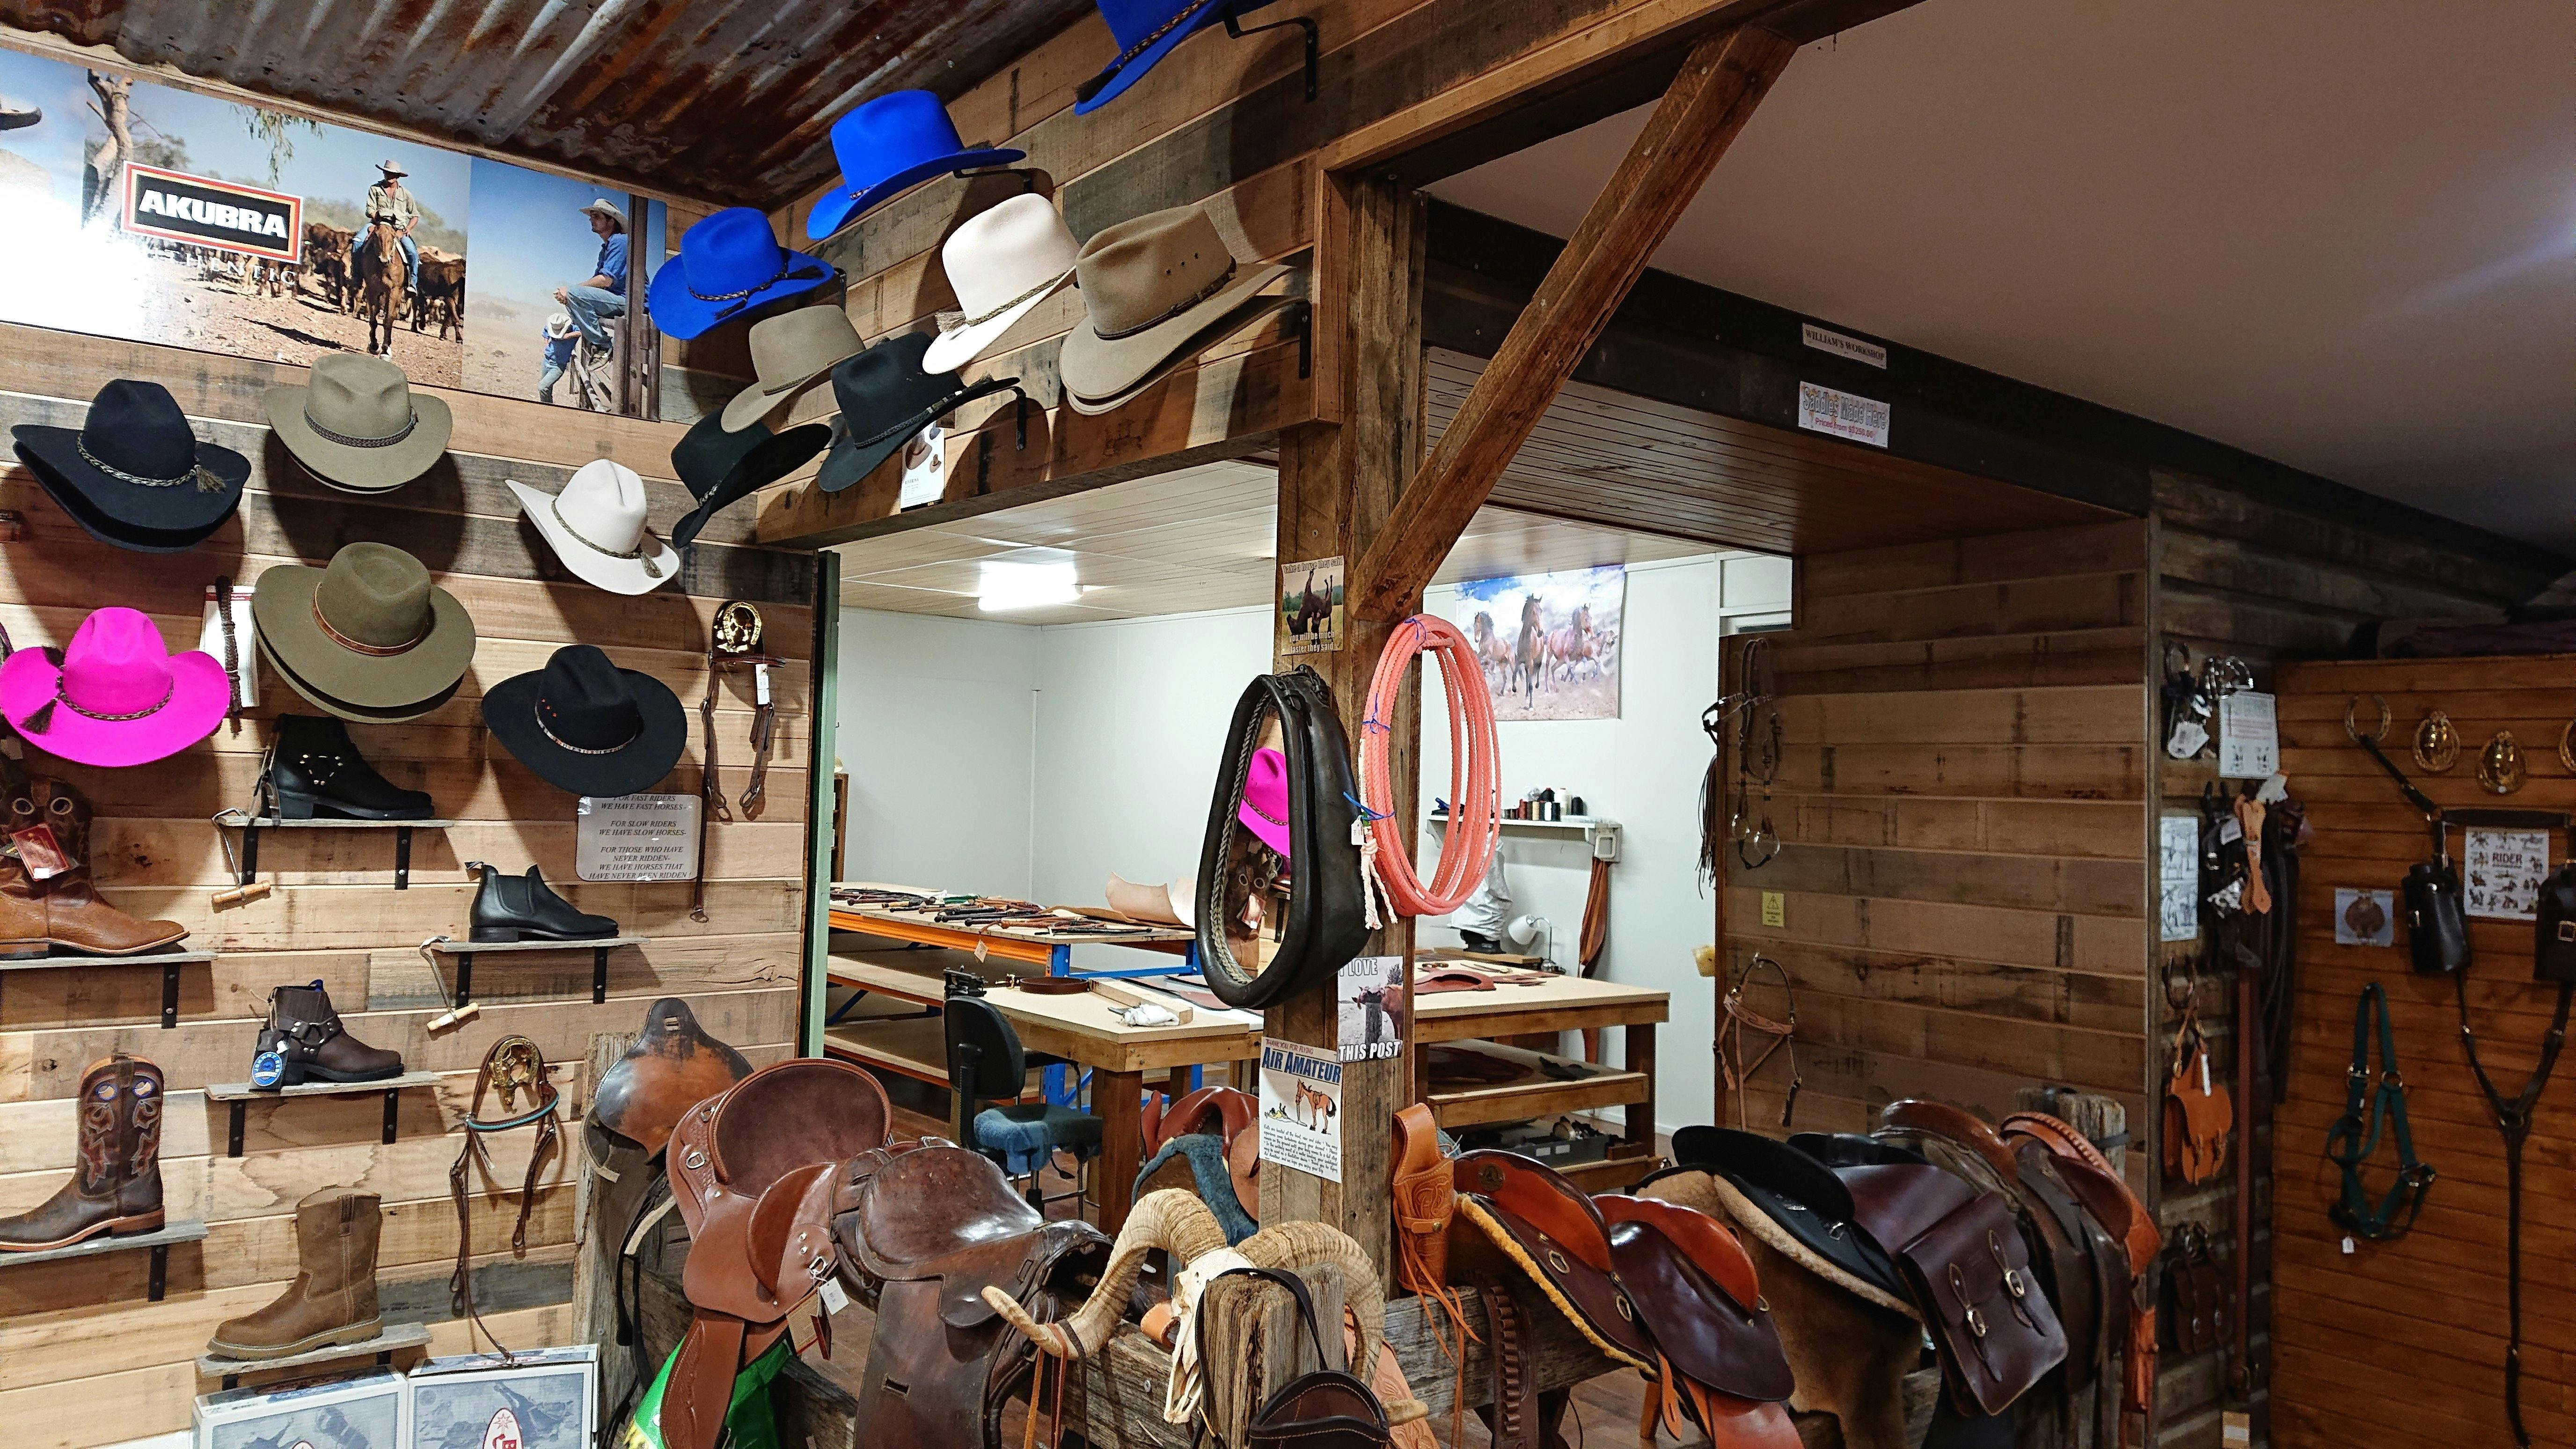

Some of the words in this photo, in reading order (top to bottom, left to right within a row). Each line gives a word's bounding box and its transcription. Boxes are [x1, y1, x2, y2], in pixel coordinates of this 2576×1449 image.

[139, 189, 288, 239] AKUBRA
[146, 247, 296, 285] THENTIC
[1806, 329, 1844, 349] WILLIAM'S
[1846, 342, 1884, 360] WORKSHOP
[1803, 387, 1839, 417] Saddles
[1301, 562, 1317, 571] horse
[1318, 560, 1330, 569] they
[1331, 557, 1342, 567] said
[1289, 634, 1299, 643] you
[1319, 629, 1334, 639] much
[1290, 645, 1307, 653] faster
[1308, 644, 1320, 652] they
[1321, 642, 1333, 651] said
[2492, 853, 2522, 864] RIDER
[1348, 959, 1378, 976] LOVE
[1299, 1046, 1313, 1054] FLYING
[1339, 1044, 1367, 1061] THIS
[1369, 1041, 1400, 1059] POST
[1262, 1046, 1283, 1069] AIR
[1284, 1052, 1341, 1083] AMATEUR
